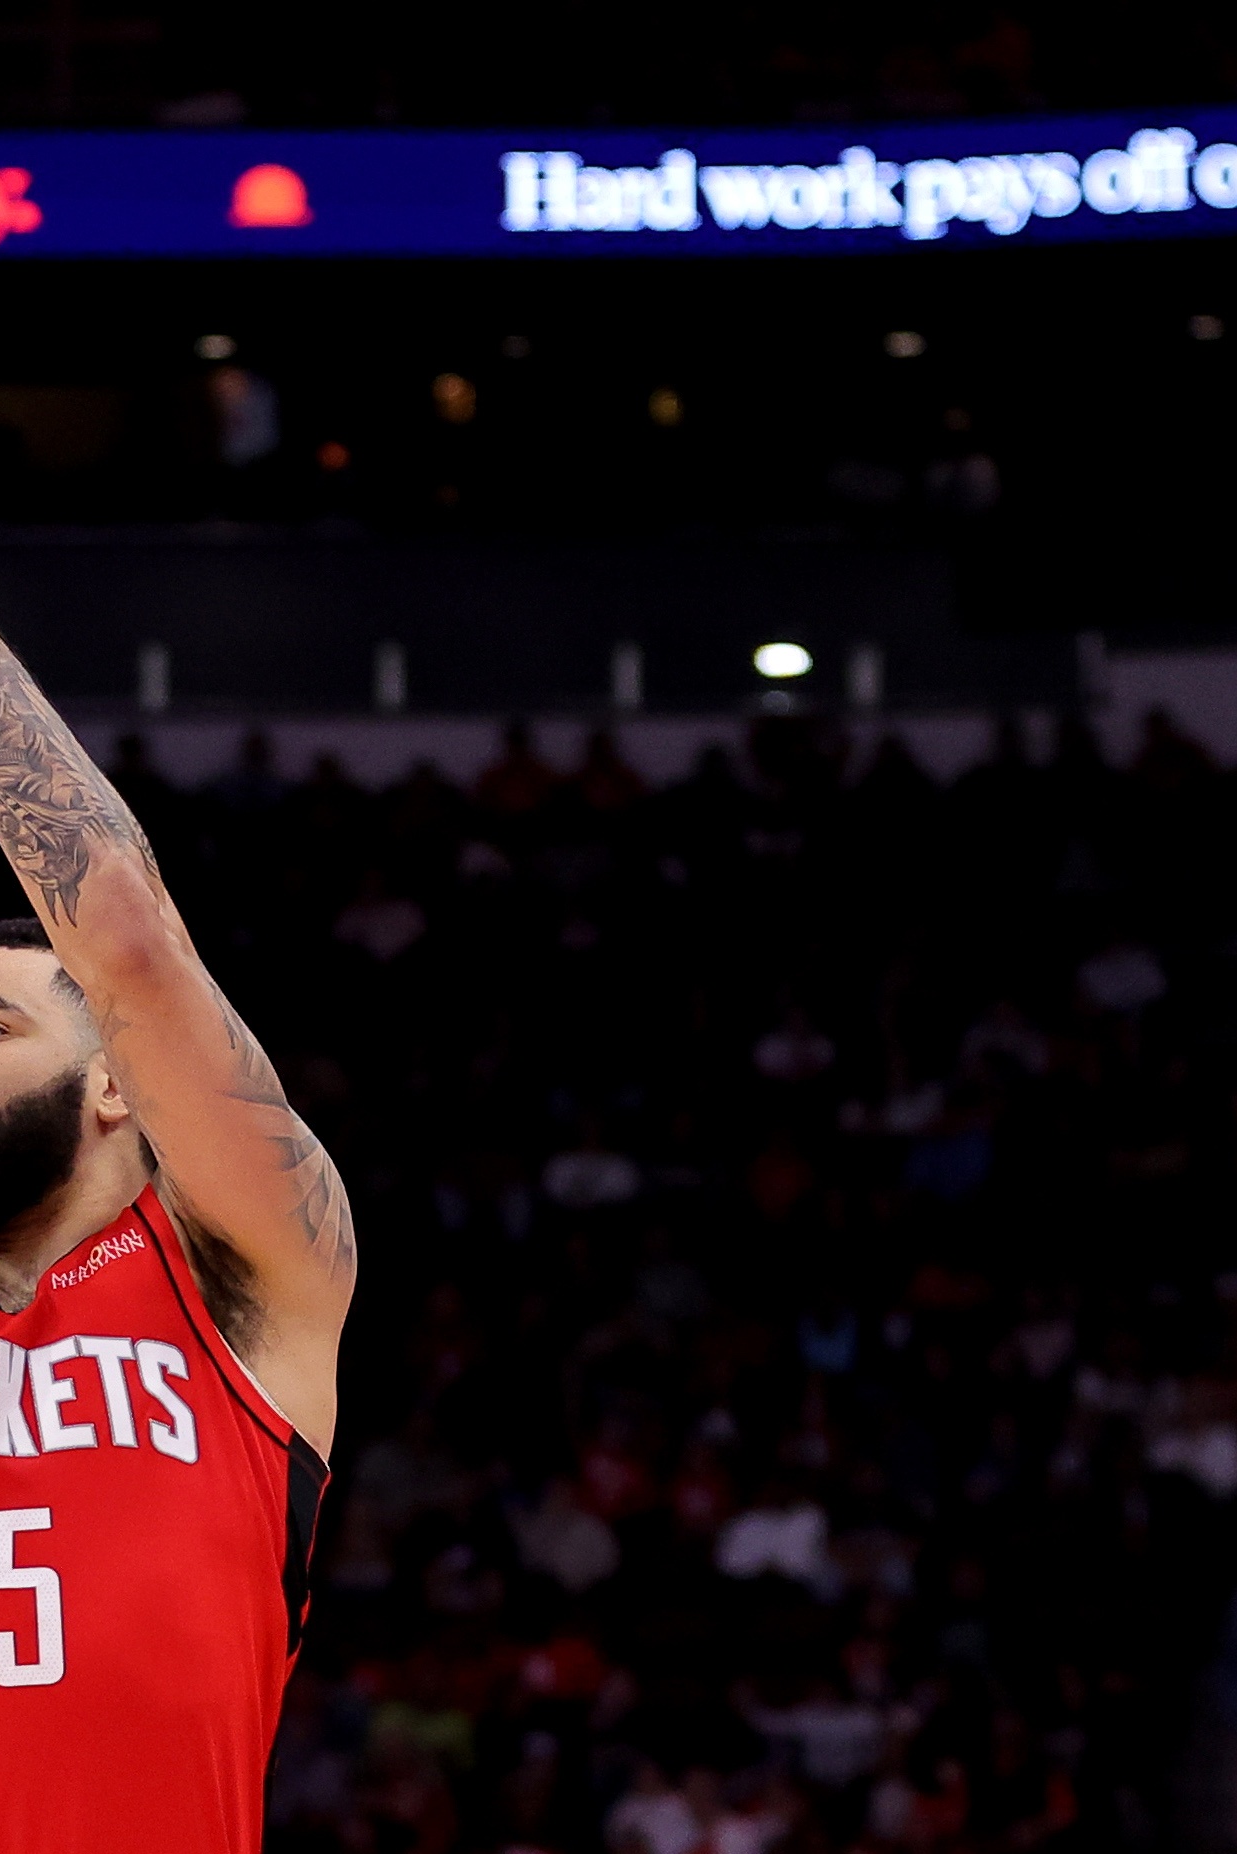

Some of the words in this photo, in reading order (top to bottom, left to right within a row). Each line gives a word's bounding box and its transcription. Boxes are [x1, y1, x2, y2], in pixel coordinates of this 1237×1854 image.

[499, 148, 702, 231] Hard
[699, 145, 904, 230] work
[900, 152, 1082, 240] pays
[1081, 126, 1197, 215] off
